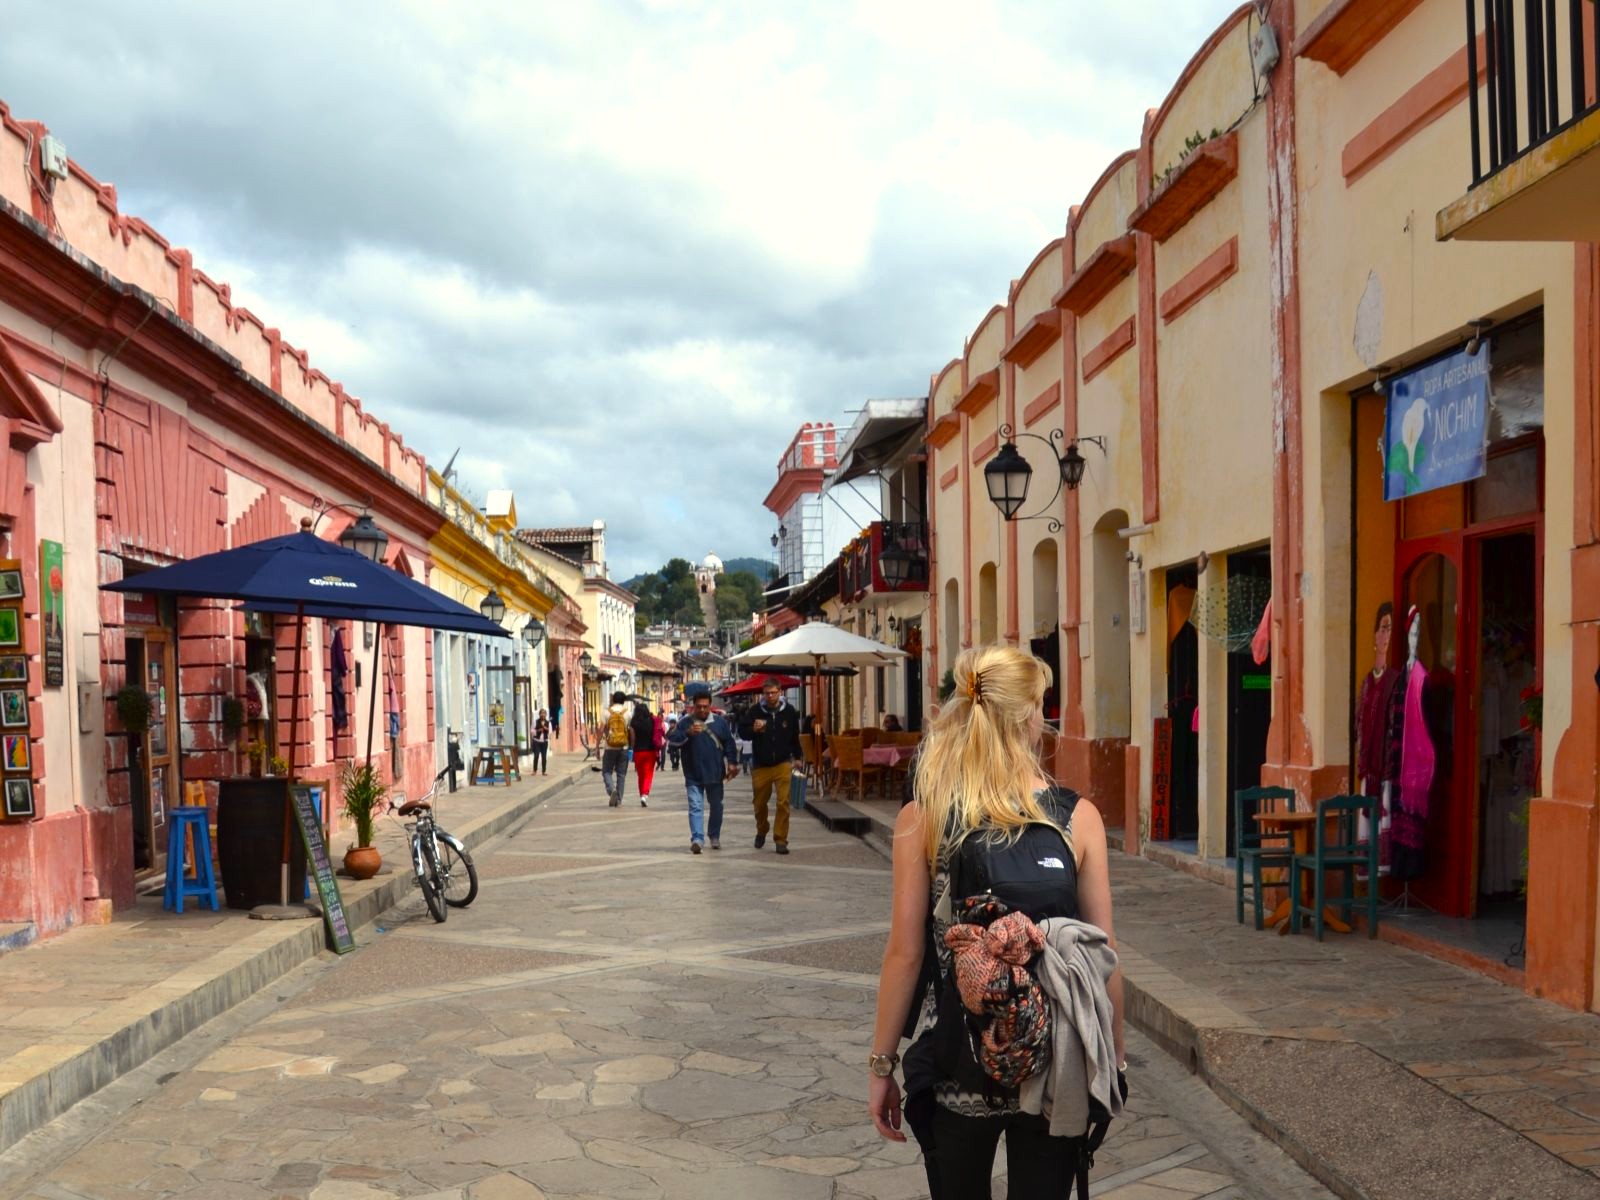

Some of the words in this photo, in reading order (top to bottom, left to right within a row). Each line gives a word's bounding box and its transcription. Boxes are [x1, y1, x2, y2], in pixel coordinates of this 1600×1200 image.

[1424, 379, 1442, 397] ROPA
[1442, 360, 1487, 388] ARTESANAL
[1433, 393, 1477, 444] NICHIM
[308, 578, 358, 588] Corona
